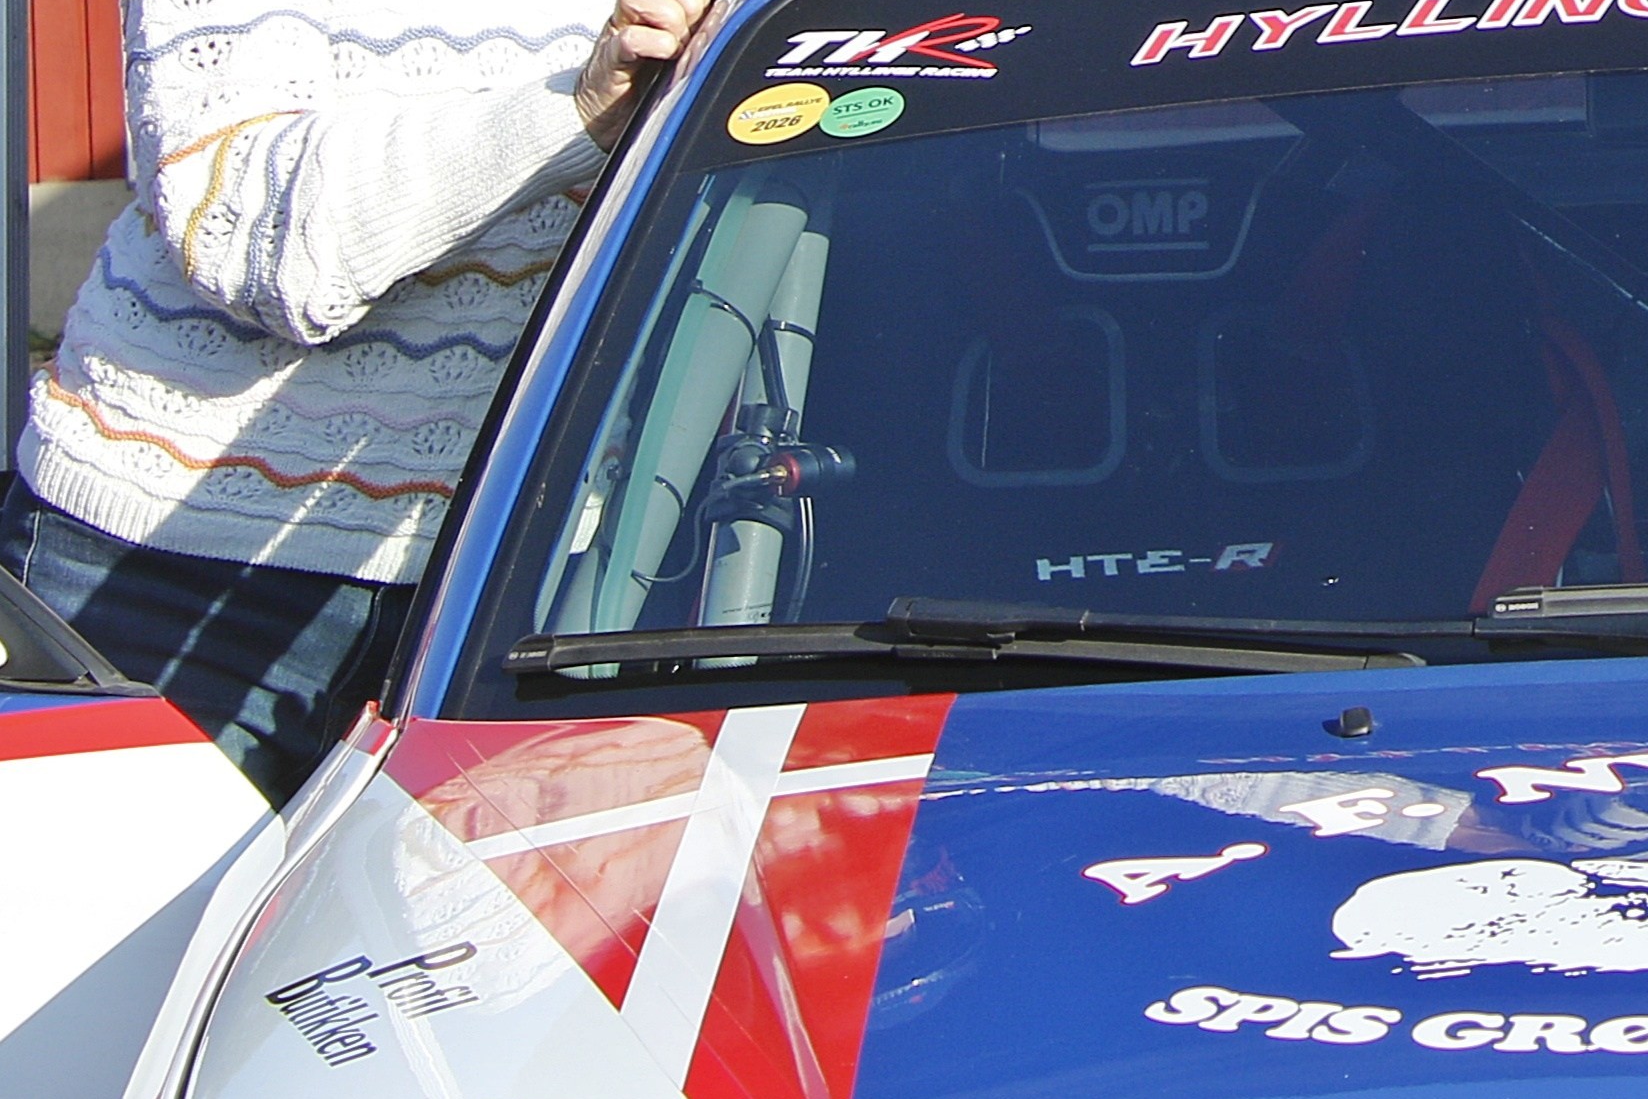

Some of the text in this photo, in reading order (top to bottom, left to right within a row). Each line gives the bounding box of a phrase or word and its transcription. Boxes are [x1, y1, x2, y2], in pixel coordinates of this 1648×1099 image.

[765, 68, 822, 78] TEAM
[919, 66, 998, 79] RACING
[750, 114, 804, 133] 2026
[832, 95, 895, 116] STS OK
[1087, 191, 1208, 237] OMP
[1037, 542, 1281, 580] HTE-R
[1083, 842, 1269, 904] A.
[1280, 787, 1446, 837] E.
[366, 940, 480, 1020] Profil
[264, 955, 380, 1068] Butikken
[1144, 986, 1402, 1045] SPIS
